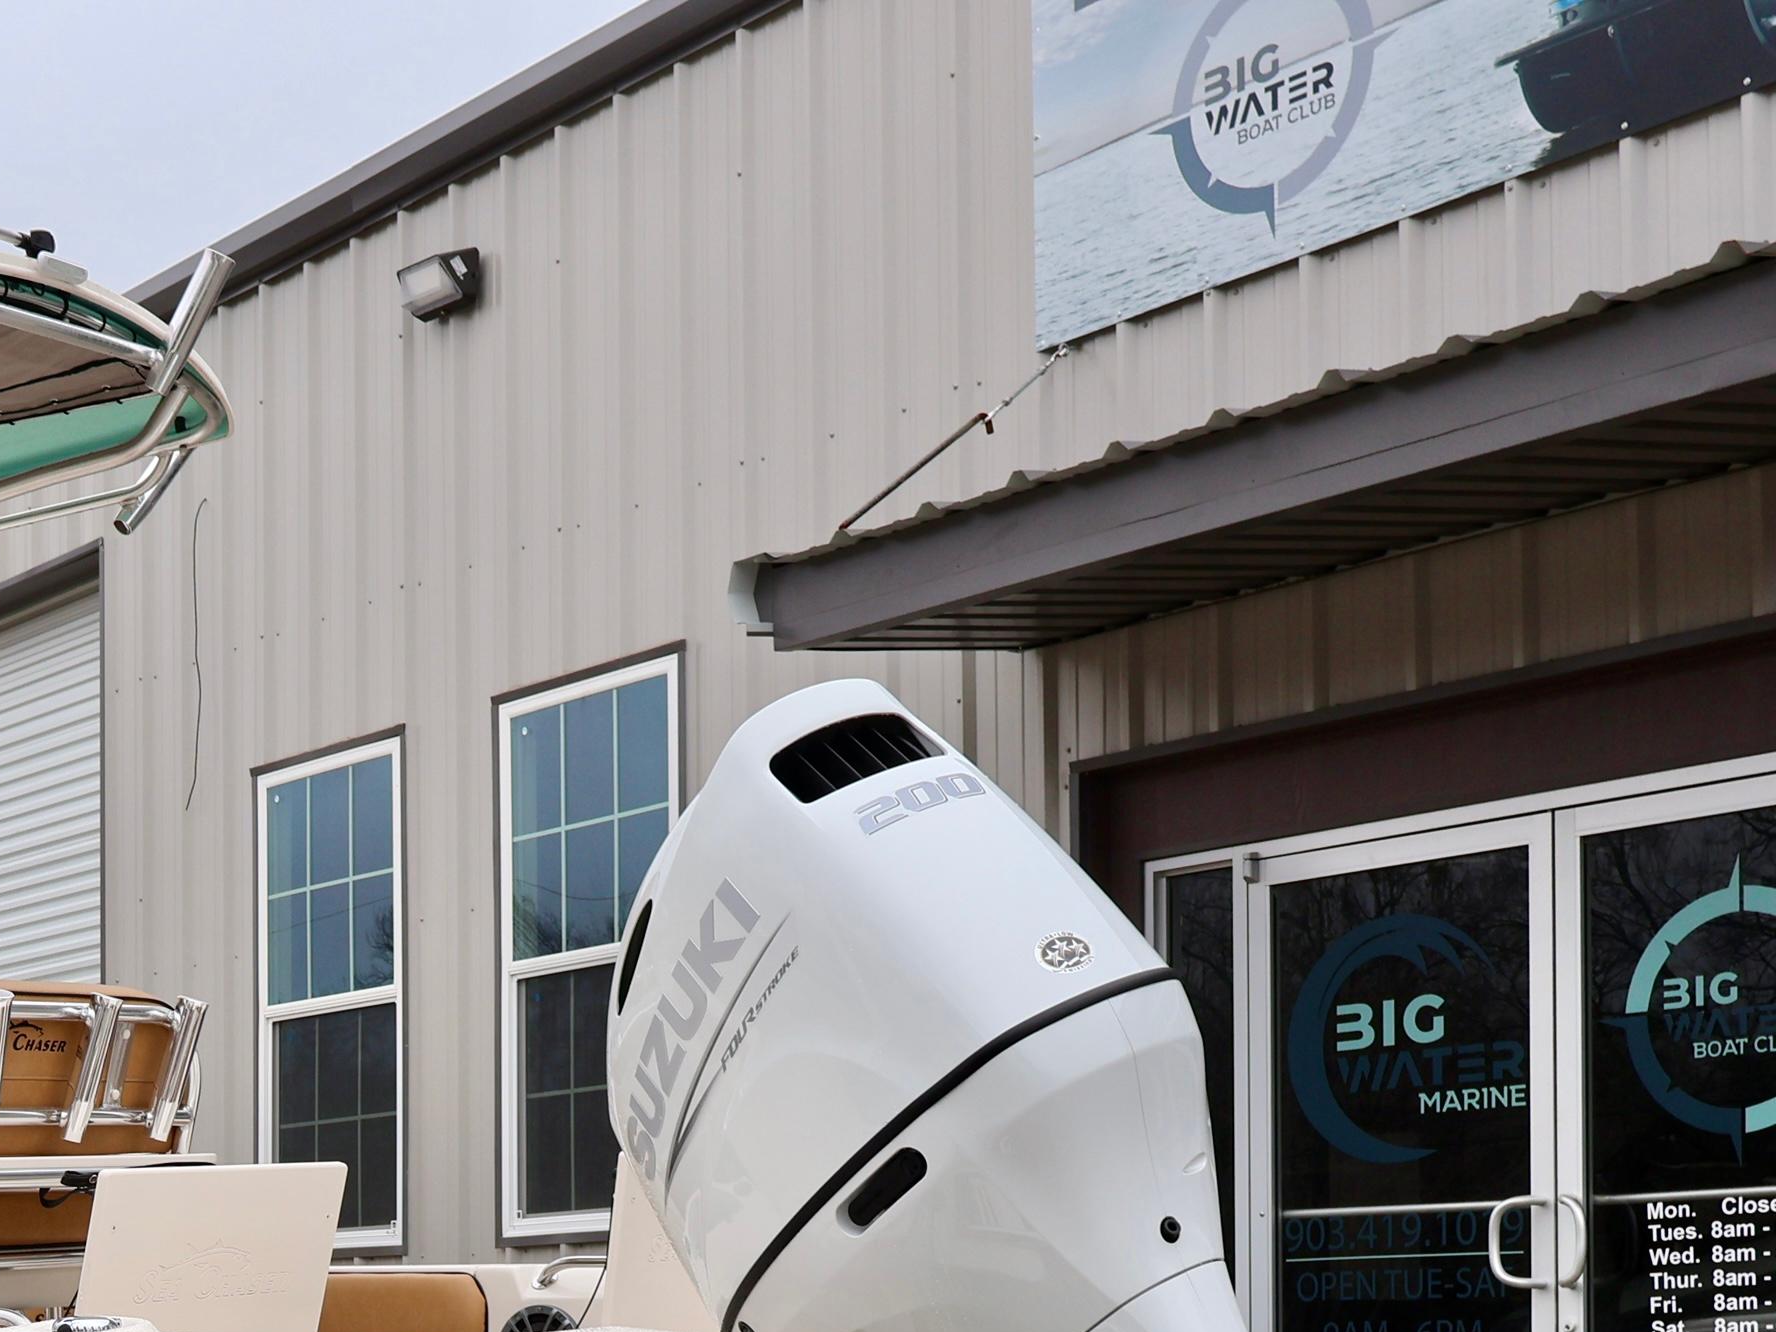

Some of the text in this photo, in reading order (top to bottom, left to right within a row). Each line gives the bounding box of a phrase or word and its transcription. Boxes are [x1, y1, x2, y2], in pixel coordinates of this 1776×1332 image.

[1205, 44, 1279, 107] BIG
[1205, 62, 1334, 135] WATER
[1237, 93, 1336, 145] BOAT CLUB
[854, 773, 986, 838] 200
[1663, 971, 1738, 1010] BIG
[627, 876, 761, 1181] SUZUKI
[1336, 994, 1445, 1052] BIG
[12, 1033, 67, 1053] CHASER
[1692, 1037, 1748, 1059] BOAT
[1337, 1040, 1523, 1094] WATER
[1418, 1084, 1527, 1115] MARINE
[1646, 1202, 1697, 1220] Mon.
[1285, 1210, 1524, 1251] 903.419.109
[1647, 1224, 1703, 1242] Tues.
[1711, 1221, 1755, 1239] 8am
[1649, 1246, 1701, 1266] Wed.
[1711, 1245, 1756, 1263] 8am
[1296, 1270, 1375, 1302] OPEN
[1649, 1271, 1703, 1290] Thur.
[1712, 1269, 1757, 1287] 8am
[1649, 1295, 1683, 1314] Fri.
[1713, 1294, 1758, 1311] 8am
